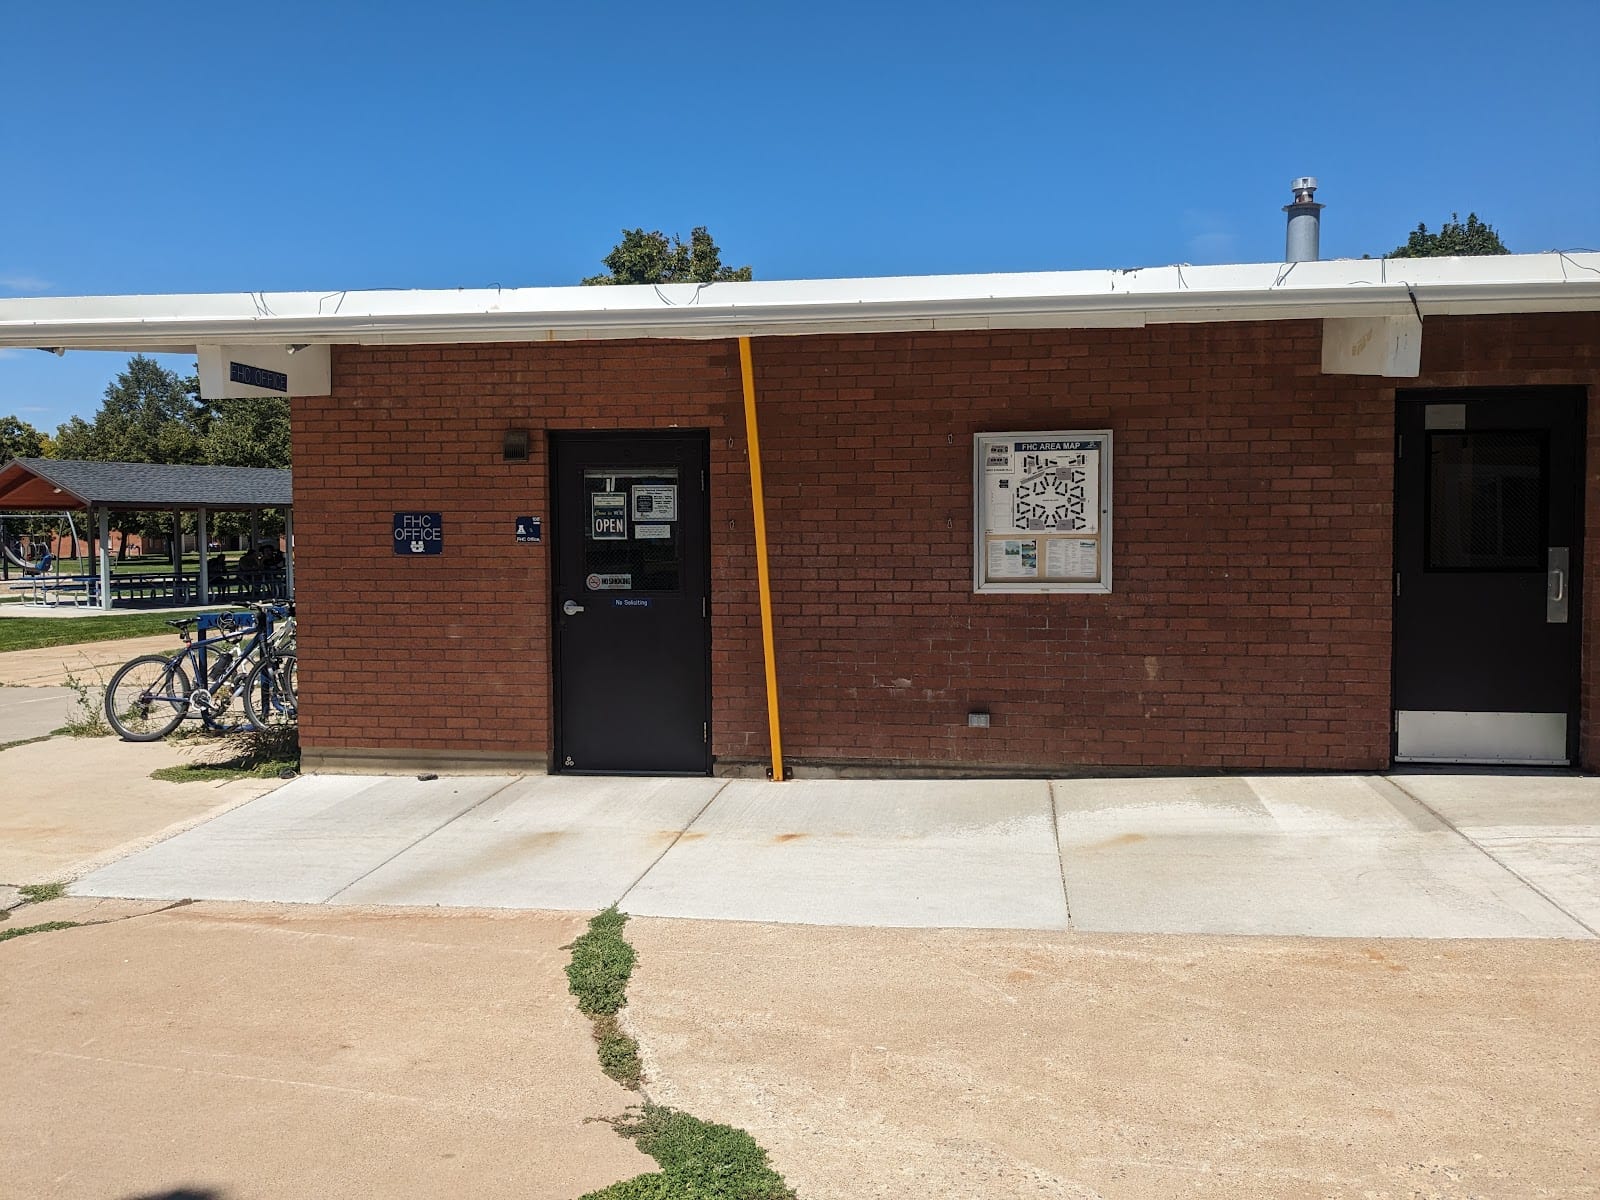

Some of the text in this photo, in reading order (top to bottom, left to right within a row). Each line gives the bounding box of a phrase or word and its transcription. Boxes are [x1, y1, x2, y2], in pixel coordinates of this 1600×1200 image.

[231, 364, 286, 391] FHC OFFICE
[1022, 441, 1081, 451] FHC AREA MAP
[403, 515, 431, 527] FHC
[595, 518, 624, 533] OPEN
[394, 528, 441, 540] OFFICE
